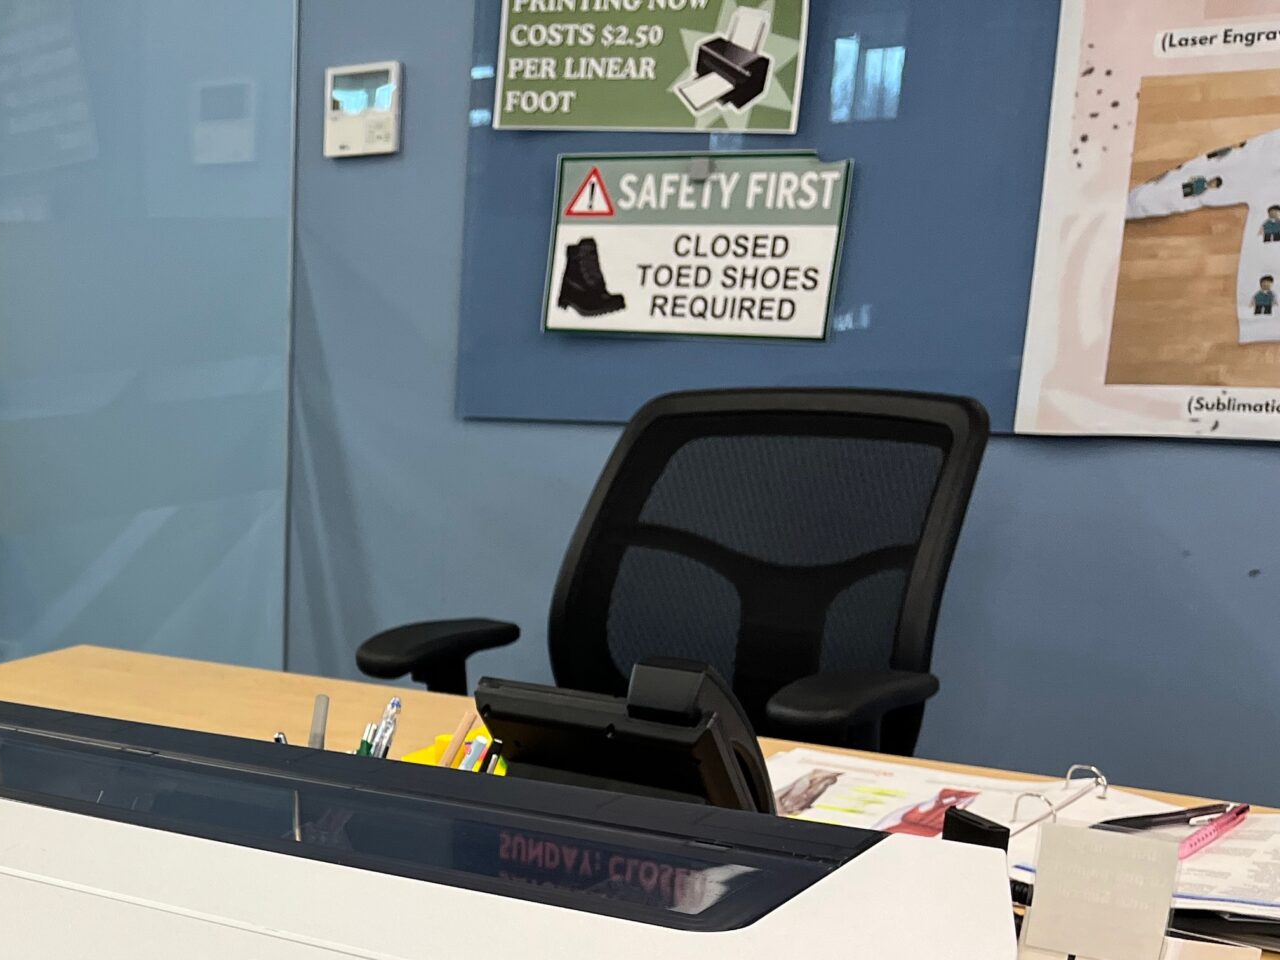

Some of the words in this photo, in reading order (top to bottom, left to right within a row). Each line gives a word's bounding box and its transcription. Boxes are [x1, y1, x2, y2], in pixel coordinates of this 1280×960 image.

[510, 23, 595, 47] COSTS
[601, 25, 664, 48] $2.50
[1161, 32, 1218, 52] (Laser
[507, 57, 556, 80] PER
[563, 57, 656, 80] LINEAR
[504, 90, 576, 113] FOOT
[618, 171, 741, 210] SAFETY
[745, 171, 841, 210] FIRST
[674, 234, 789, 258] CLOSED
[637, 264, 712, 288] TOED
[721, 265, 819, 290] SHOES
[650, 295, 796, 321] REQUIRED
